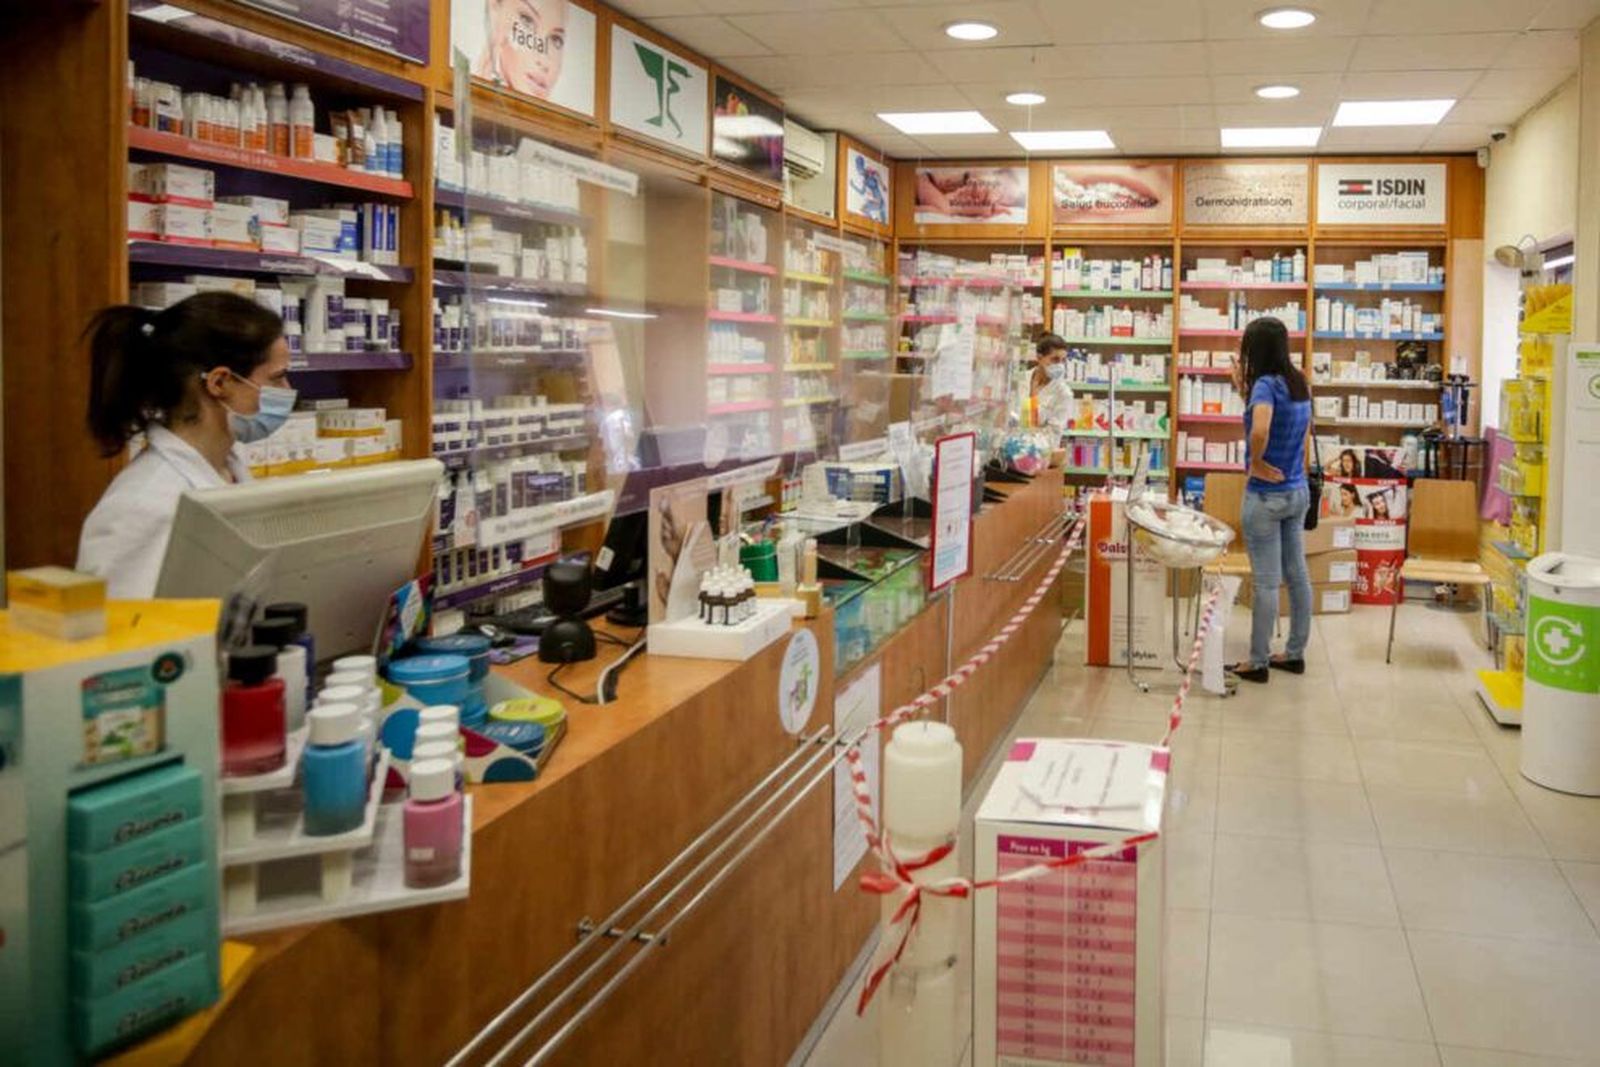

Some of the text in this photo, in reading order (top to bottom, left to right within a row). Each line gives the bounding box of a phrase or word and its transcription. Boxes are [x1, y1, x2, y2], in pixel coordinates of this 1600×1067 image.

[511, 21, 549, 55] facial
[1376, 178, 1426, 196] ISDIN
[1060, 197, 1092, 209] Salud
[1338, 197, 1426, 211] corporal/facial
